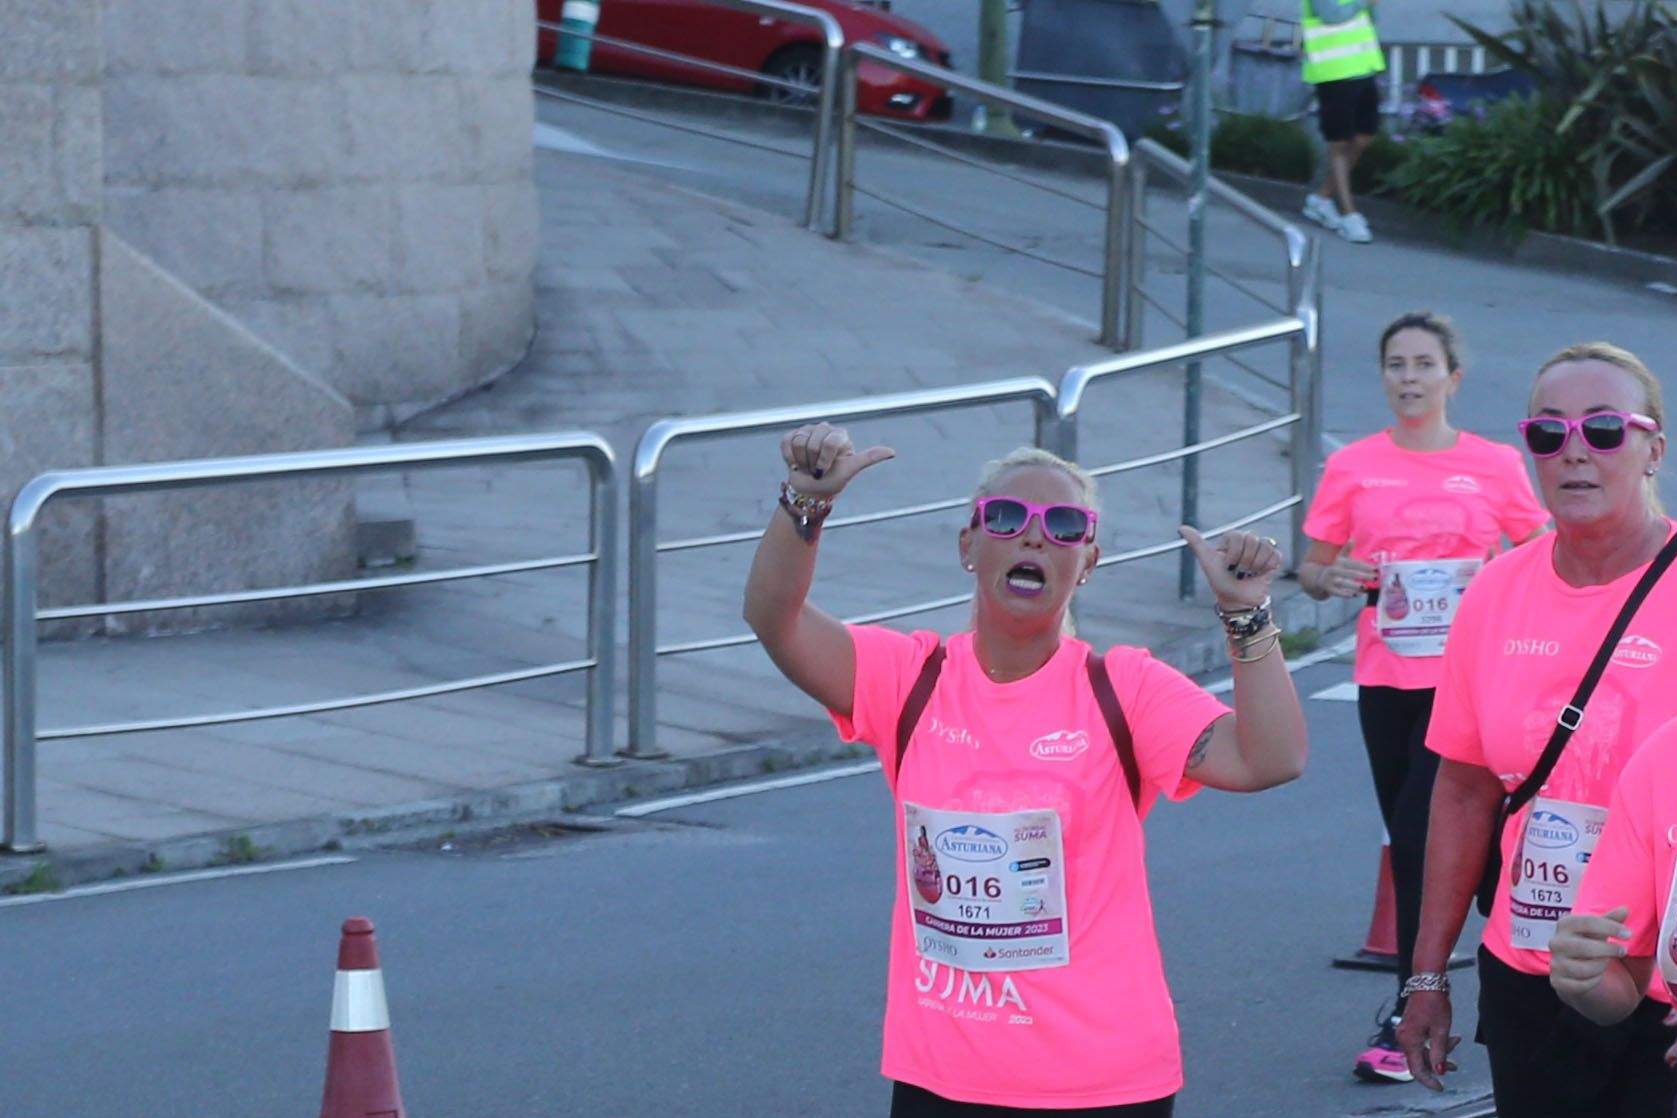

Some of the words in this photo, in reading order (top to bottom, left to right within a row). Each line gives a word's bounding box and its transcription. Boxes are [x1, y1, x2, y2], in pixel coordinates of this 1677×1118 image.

[1412, 597, 1448, 612] 016
[1014, 831, 1048, 842] SUMA
[939, 836, 1003, 857] ASTURIANA
[1524, 858, 1569, 884] 016
[945, 874, 1002, 899] 016
[1531, 888, 1563, 903] 1673
[958, 903, 990, 920] 1671
[1530, 908, 1544, 917] DE
[956, 924, 970, 935] DE
[970, 926, 984, 936] LA
[985, 927, 1022, 937] MUJER
[1025, 923, 1049, 935] 2023
[998, 945, 1054, 960] Santander
